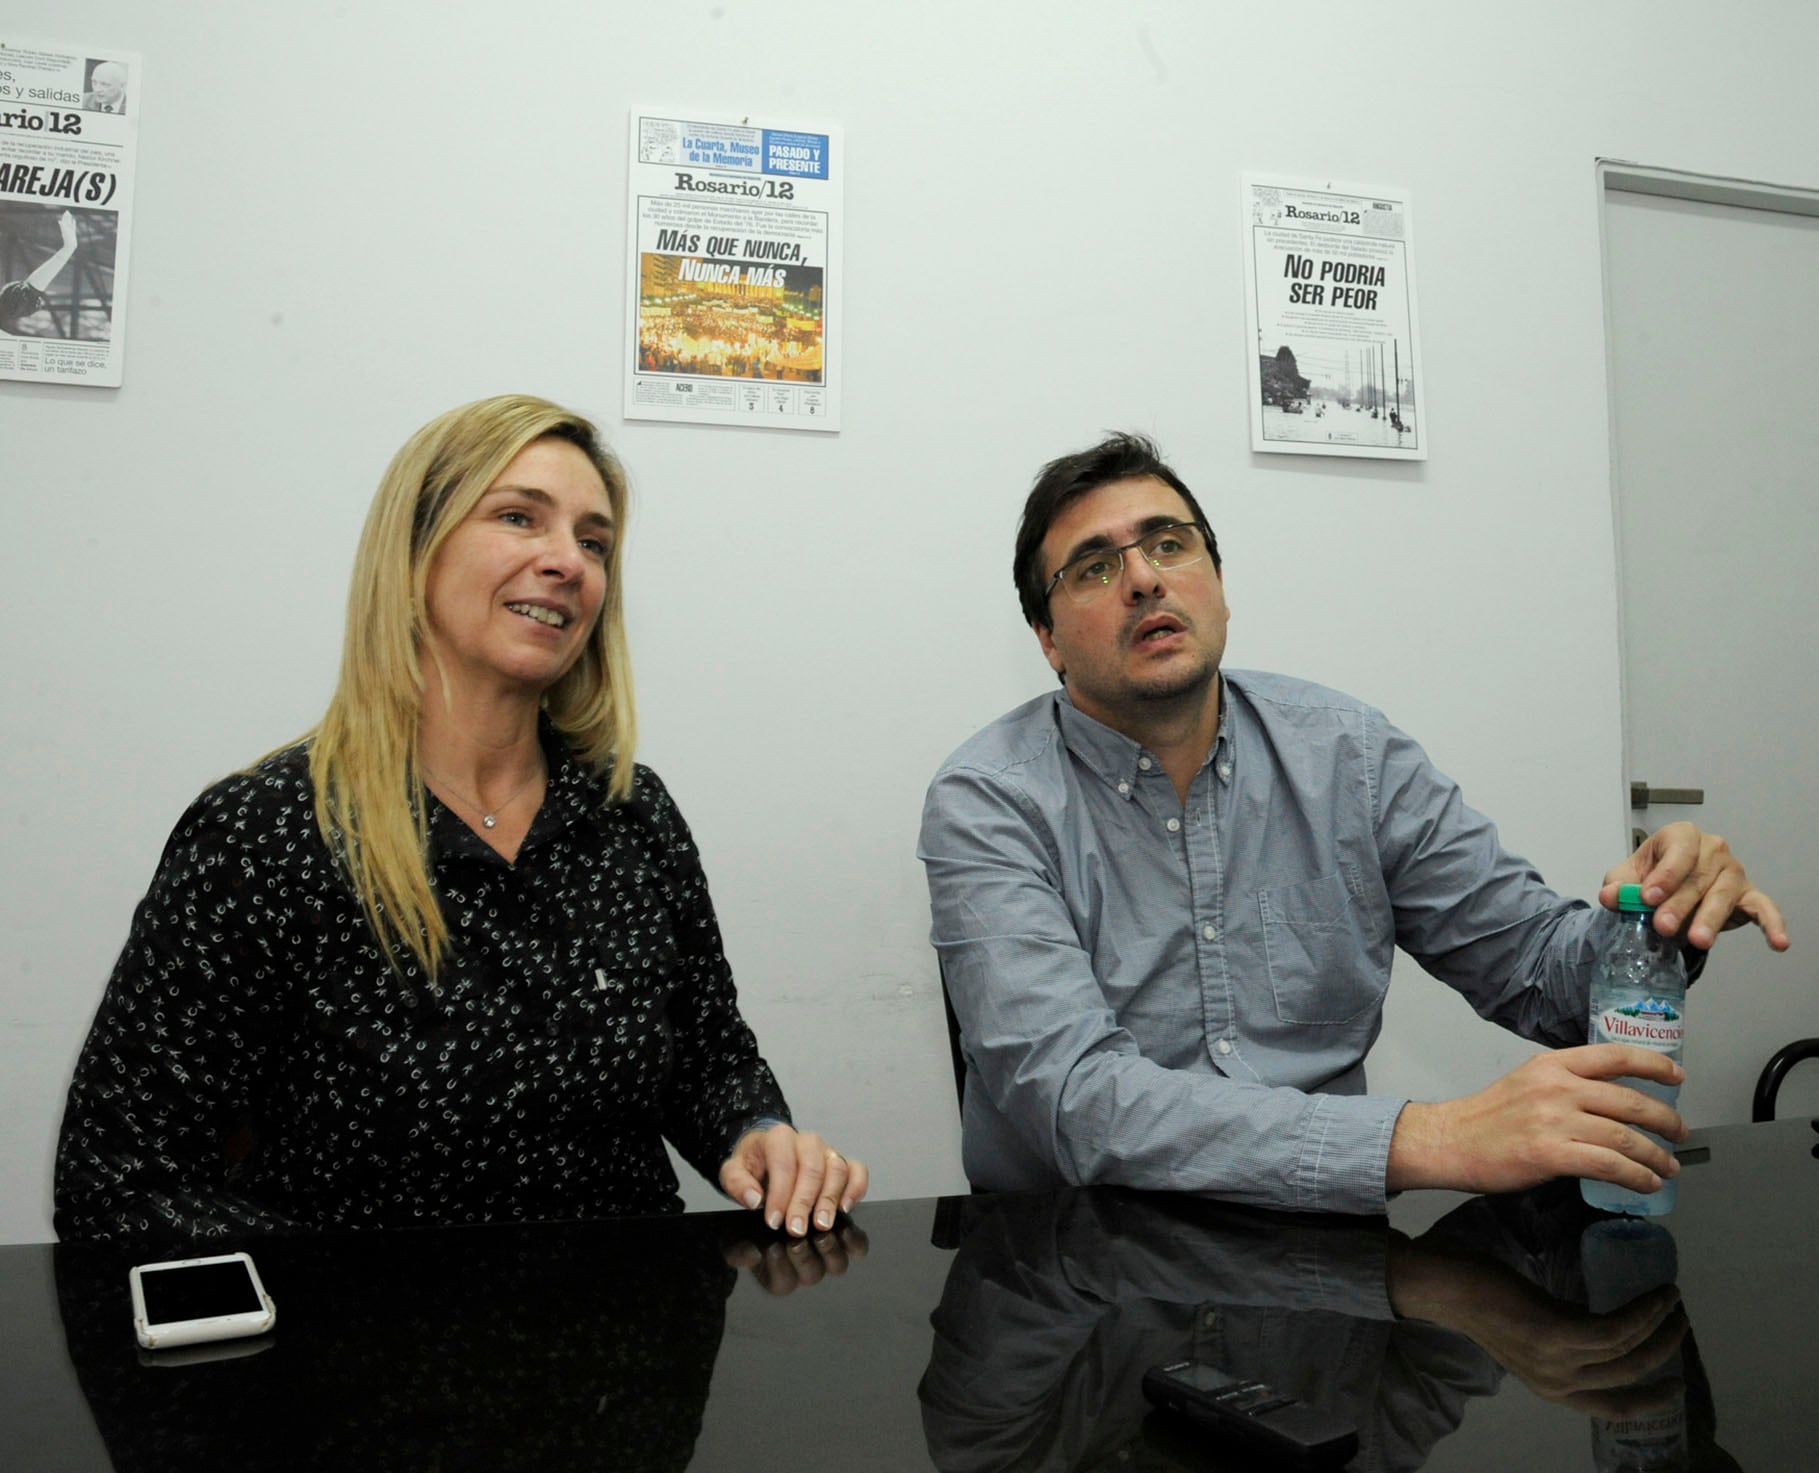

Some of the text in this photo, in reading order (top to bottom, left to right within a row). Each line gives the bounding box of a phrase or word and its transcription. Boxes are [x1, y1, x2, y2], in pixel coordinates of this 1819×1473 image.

[15, 87, 24, 99] y
[28, 87, 81, 103] salidas
[682, 137, 760, 154] La Cuarta, Museo
[769, 145, 820, 160] PASADO Y
[689, 150, 700, 162] de
[702, 152, 711, 164] la
[712, 153, 753, 167] Memoria
[769, 158, 821, 174] PRESENTE
[674, 172, 795, 200] Rosario/12
[1285, 205, 1360, 224] Rosario/12
[656, 228, 808, 267] MÁS QUE NUNCA,
[678, 258, 787, 288] NUNCA MÁS
[1284, 254, 1386, 288] NO PODRIA
[1289, 282, 1378, 311] SER PEOR
